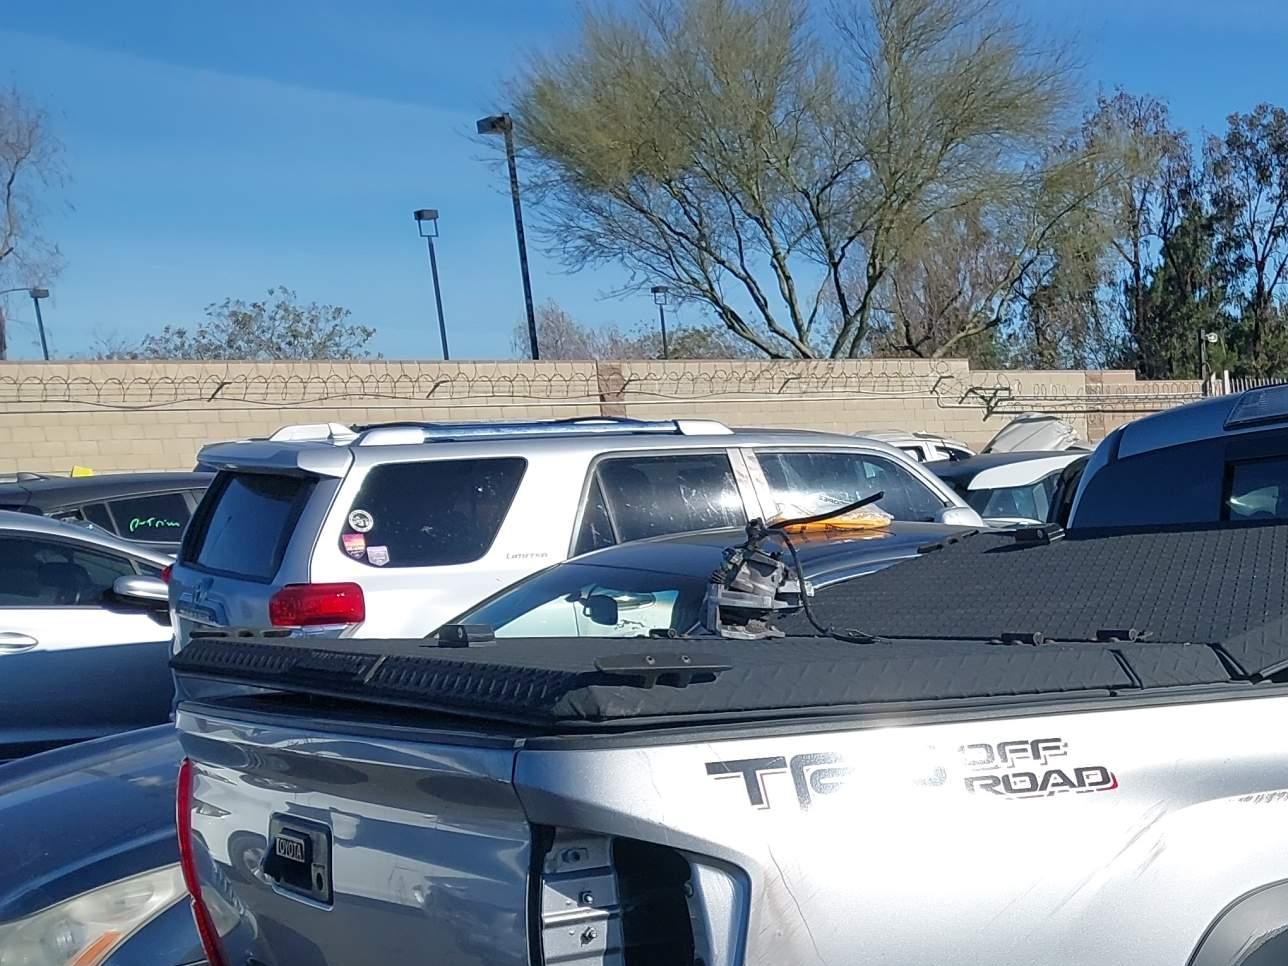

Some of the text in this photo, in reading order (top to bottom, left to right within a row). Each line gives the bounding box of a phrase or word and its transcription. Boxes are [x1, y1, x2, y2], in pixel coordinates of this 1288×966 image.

[962, 738, 1068, 768] OFF
[964, 766, 1118, 799] ROAD
[277, 837, 303, 860] TOYOTA
